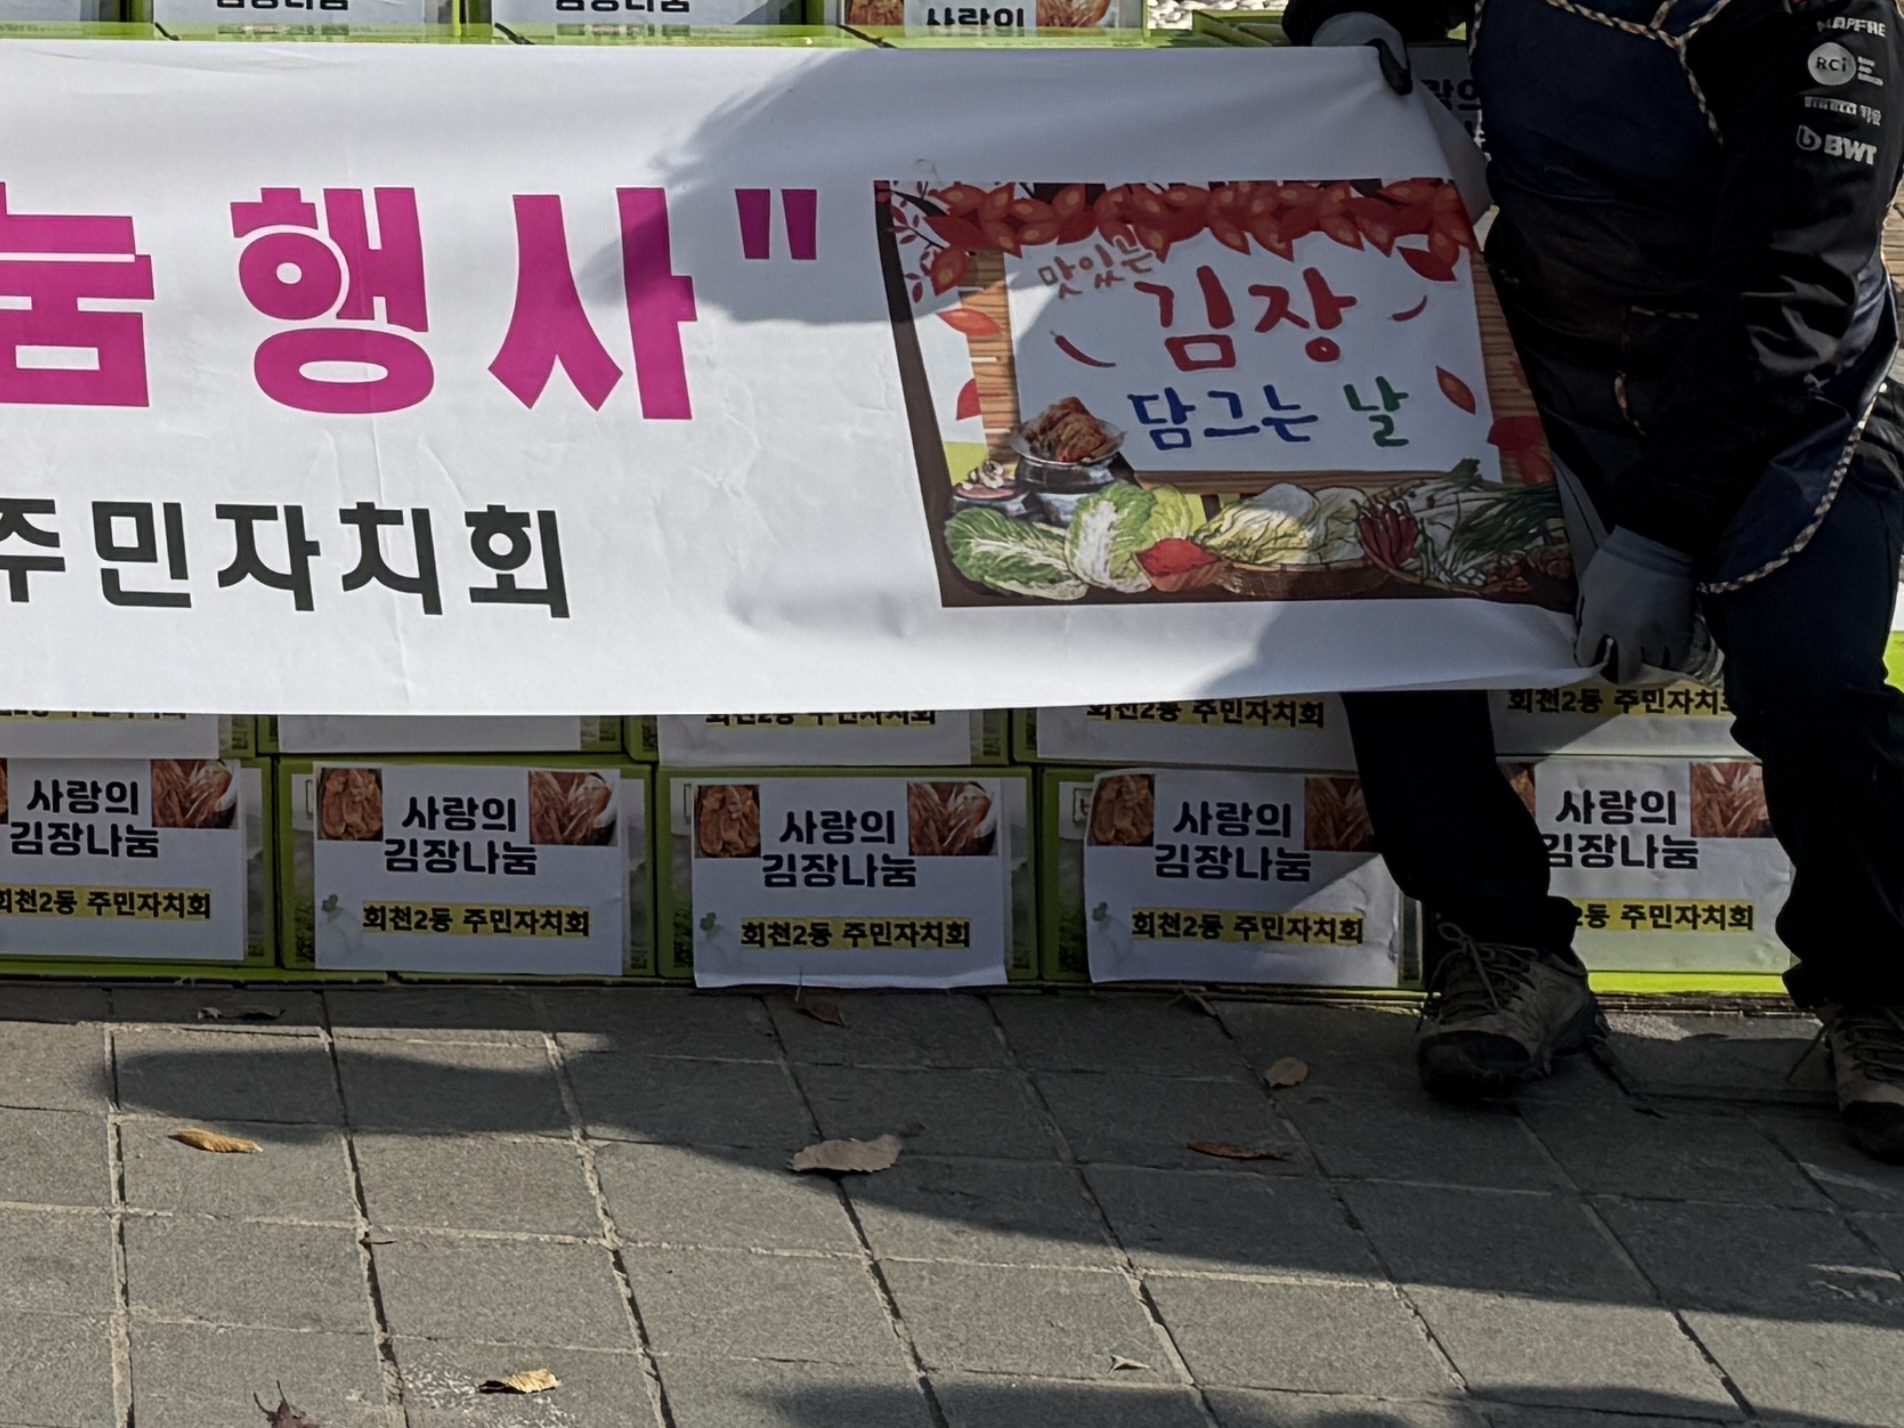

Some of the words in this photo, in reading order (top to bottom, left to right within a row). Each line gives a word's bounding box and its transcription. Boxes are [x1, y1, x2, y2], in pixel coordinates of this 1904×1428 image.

[1823, 133, 1878, 166] BWT
[1038, 234, 1153, 300] 맛있는
[230, 187, 820, 420] 행사"
[1134, 264, 1358, 373] 김장
[1127, 385, 1319, 451] 담그는
[1343, 375, 1410, 447] 날
[27, 780, 138, 815] 사랑의
[1556, 790, 1676, 825] 사랑의
[780, 810, 895, 844] 사랑의
[1173, 801, 1291, 838] 사랑의
[10, 822, 159, 858] 김장나눔
[763, 854, 916, 887] 김장나눔
[1155, 844, 1311, 882] 김장나눔
[87, 892, 210, 918] 주민자치회
[1621, 904, 1753, 930] 주민자치회
[741, 922, 832, 948] 회천2동
[843, 922, 969, 948] 주민자치회
[1132, 912, 1224, 939] 회천2동
[1233, 915, 1362, 944] 주민자치회
